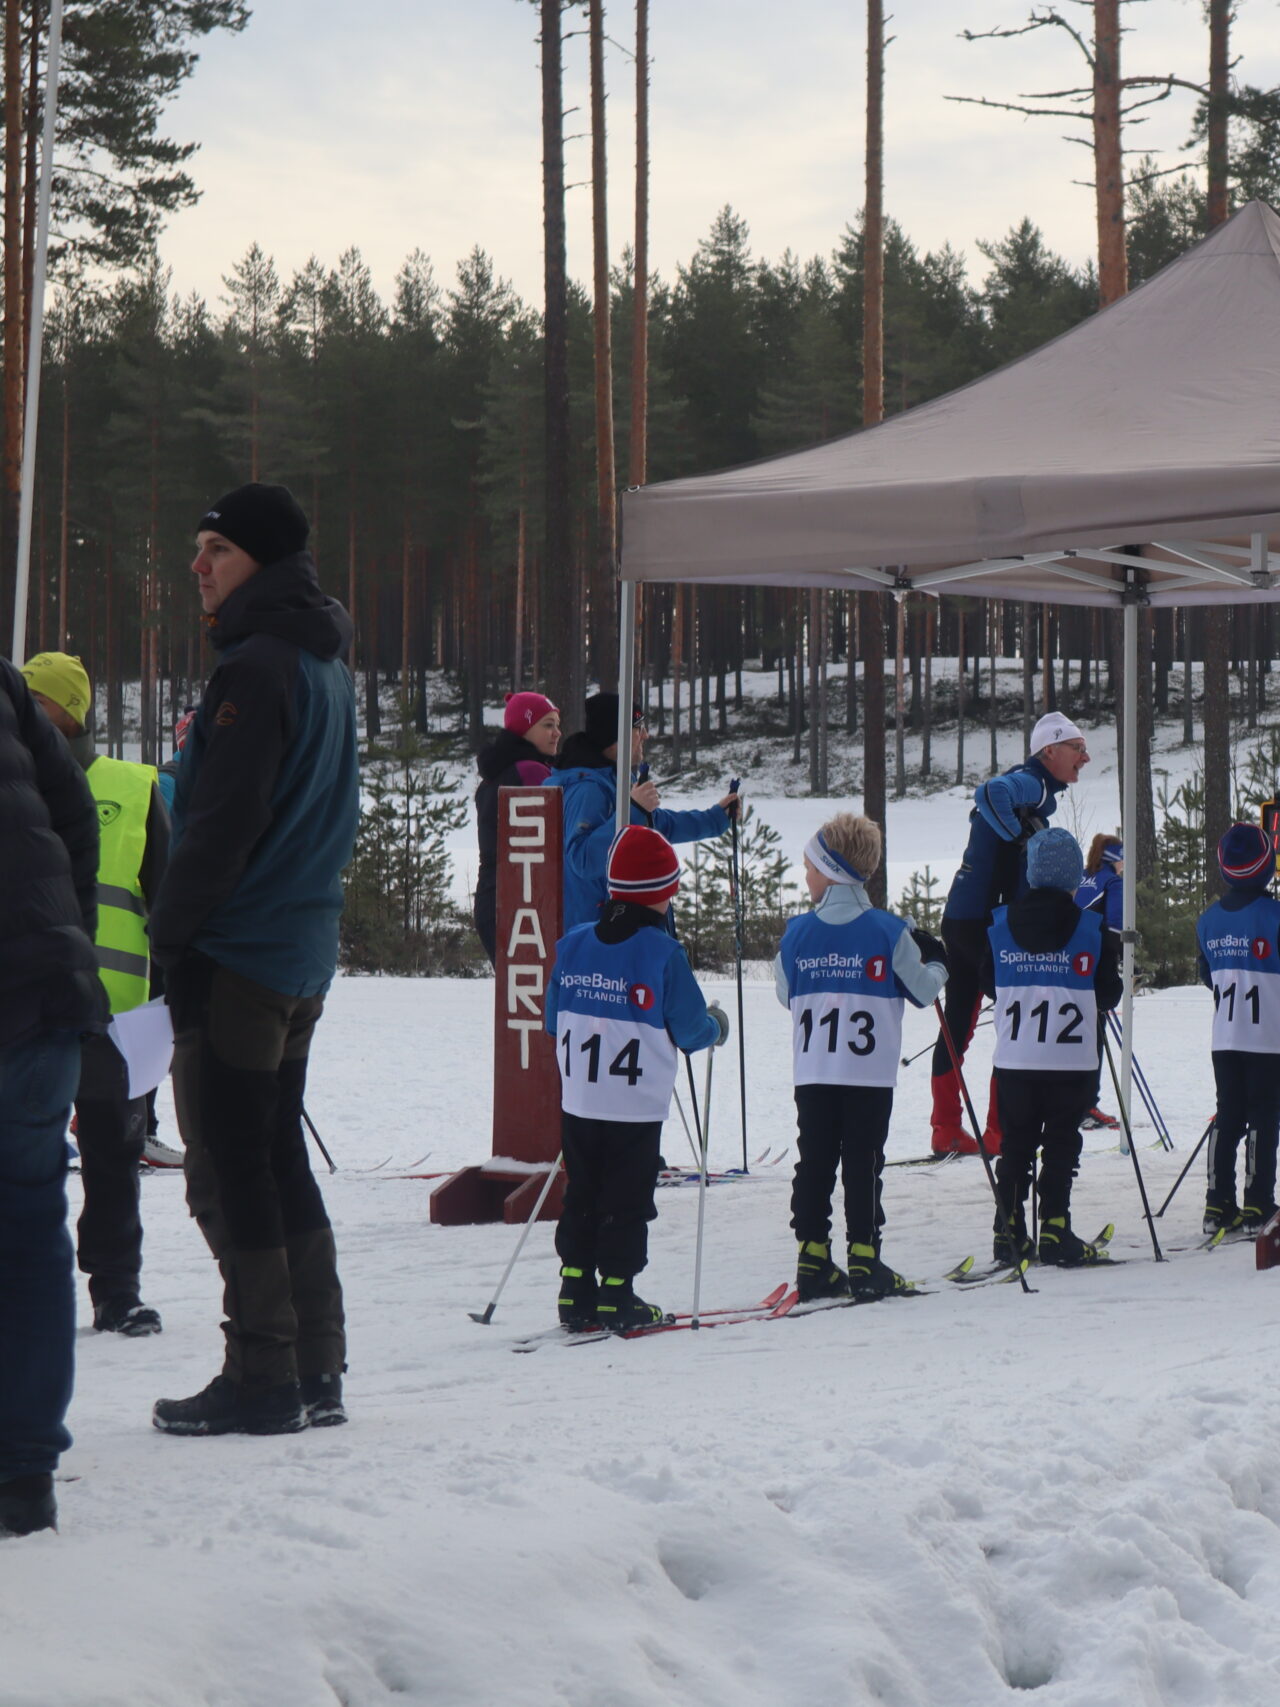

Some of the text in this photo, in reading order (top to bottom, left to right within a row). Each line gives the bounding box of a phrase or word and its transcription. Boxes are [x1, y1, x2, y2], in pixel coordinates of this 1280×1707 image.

[507, 796, 546, 1070] START
[576, 988, 629, 1006] STLANDET
[800, 1008, 876, 1056] 113
[1006, 1000, 1083, 1044] 112
[562, 1029, 643, 1086] 114
